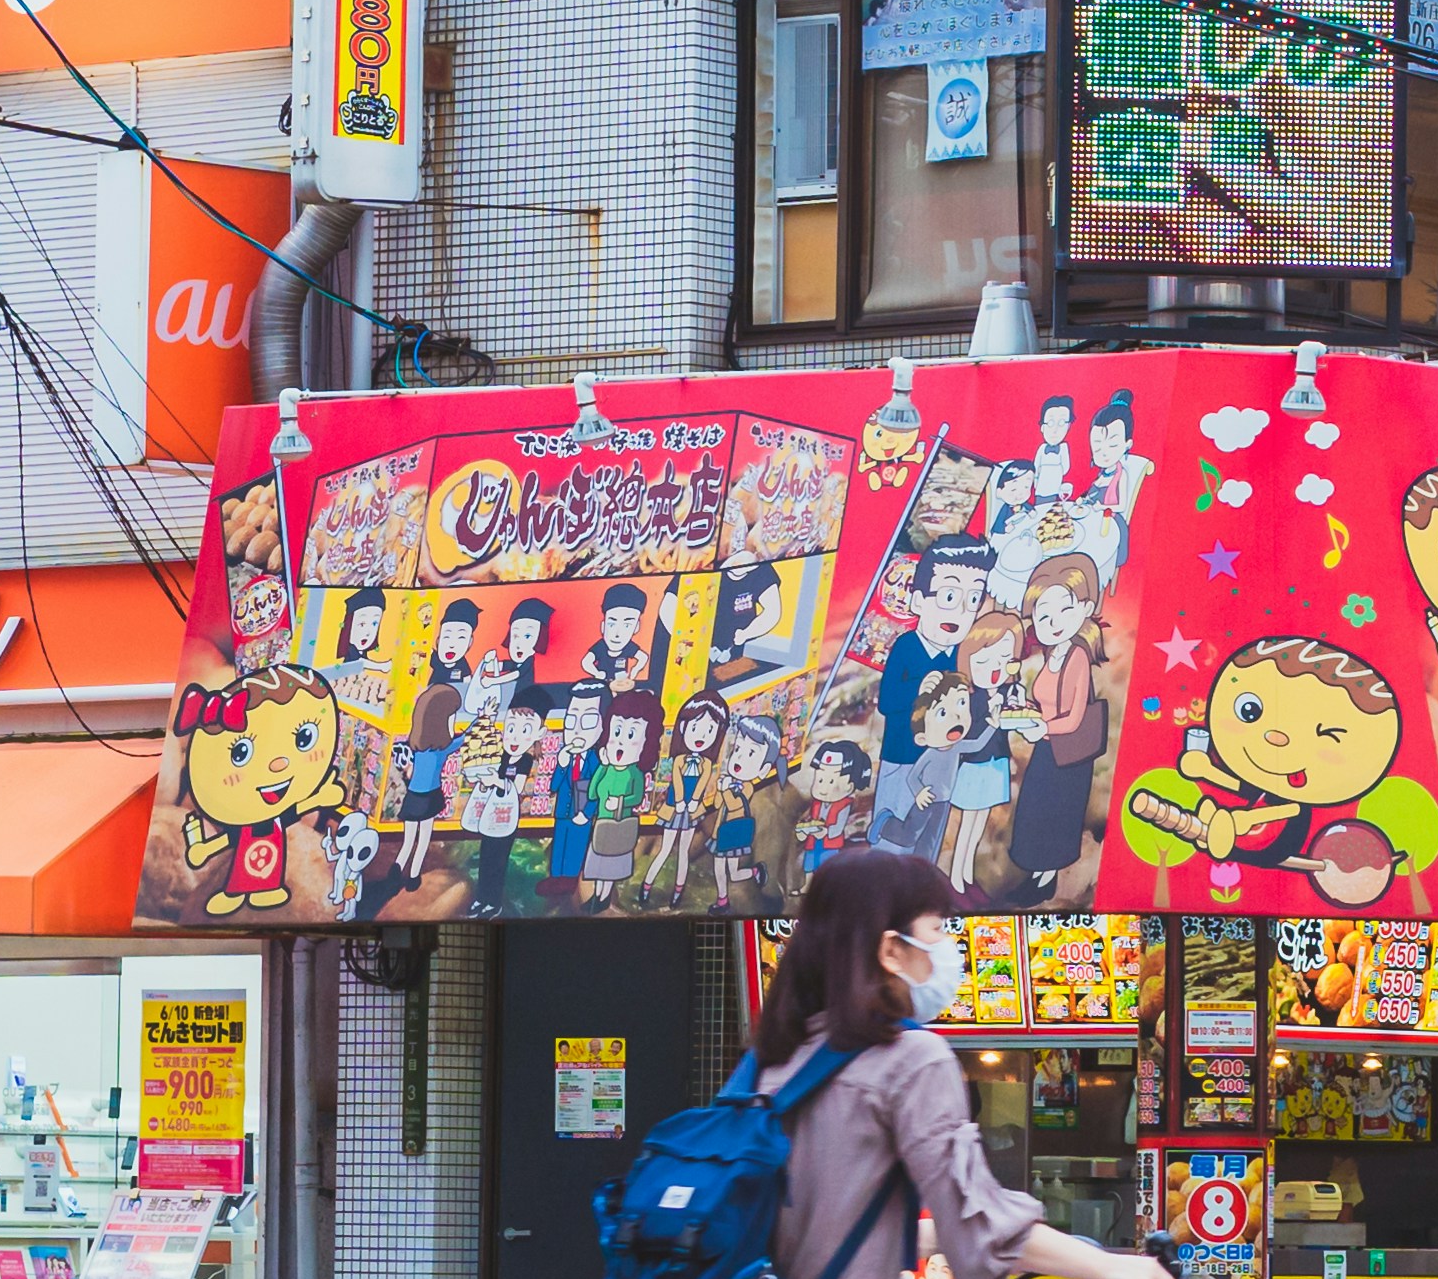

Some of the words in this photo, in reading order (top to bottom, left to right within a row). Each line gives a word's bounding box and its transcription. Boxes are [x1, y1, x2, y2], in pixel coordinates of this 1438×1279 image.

[663, 423, 727, 451] 焼そば
[160, 1005, 189, 1021] 6/10
[145, 1022, 244, 1044] でんきセット割
[168, 1070, 214, 1100] 900
[1189, 1154, 1247, 1179] 毎月
[1201, 1185, 1235, 1236] 8
[1177, 1243, 1254, 1262] のつく日は
